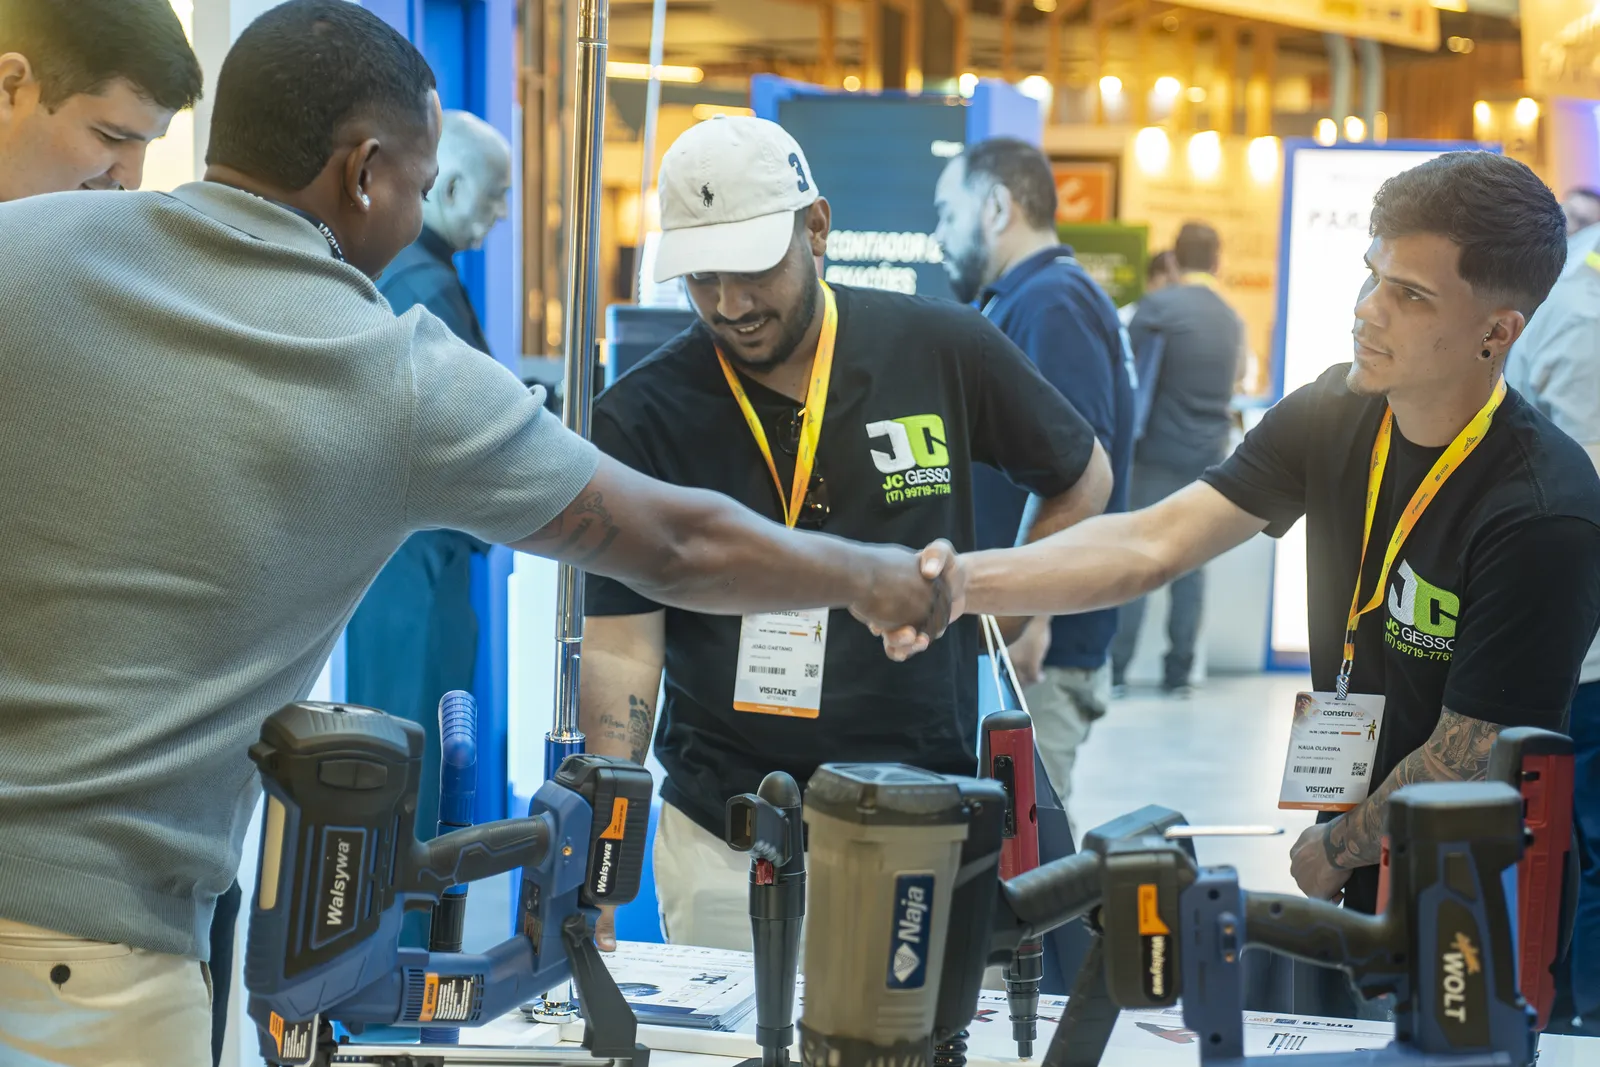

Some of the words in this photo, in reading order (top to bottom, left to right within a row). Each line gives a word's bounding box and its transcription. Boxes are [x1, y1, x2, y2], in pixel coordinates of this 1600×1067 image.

[788, 153, 809, 192] 3
[865, 413, 950, 474] JC
[882, 474, 904, 490] JC
[905, 468, 951, 485] GESSO
[886, 490, 904, 504] (17)
[1388, 558, 1460, 638] JC
[1384, 631, 1396, 648] (17)
[1386, 617, 1400, 636] JC
[759, 686, 797, 697] VISITANTE
[1305, 786, 1345, 794] VISITANTE
[326, 841, 350, 925] Walsywa
[597, 843, 612, 893] Walsywa
[898, 886, 928, 943] Naja
[1443, 952, 1466, 1023] WOLT
